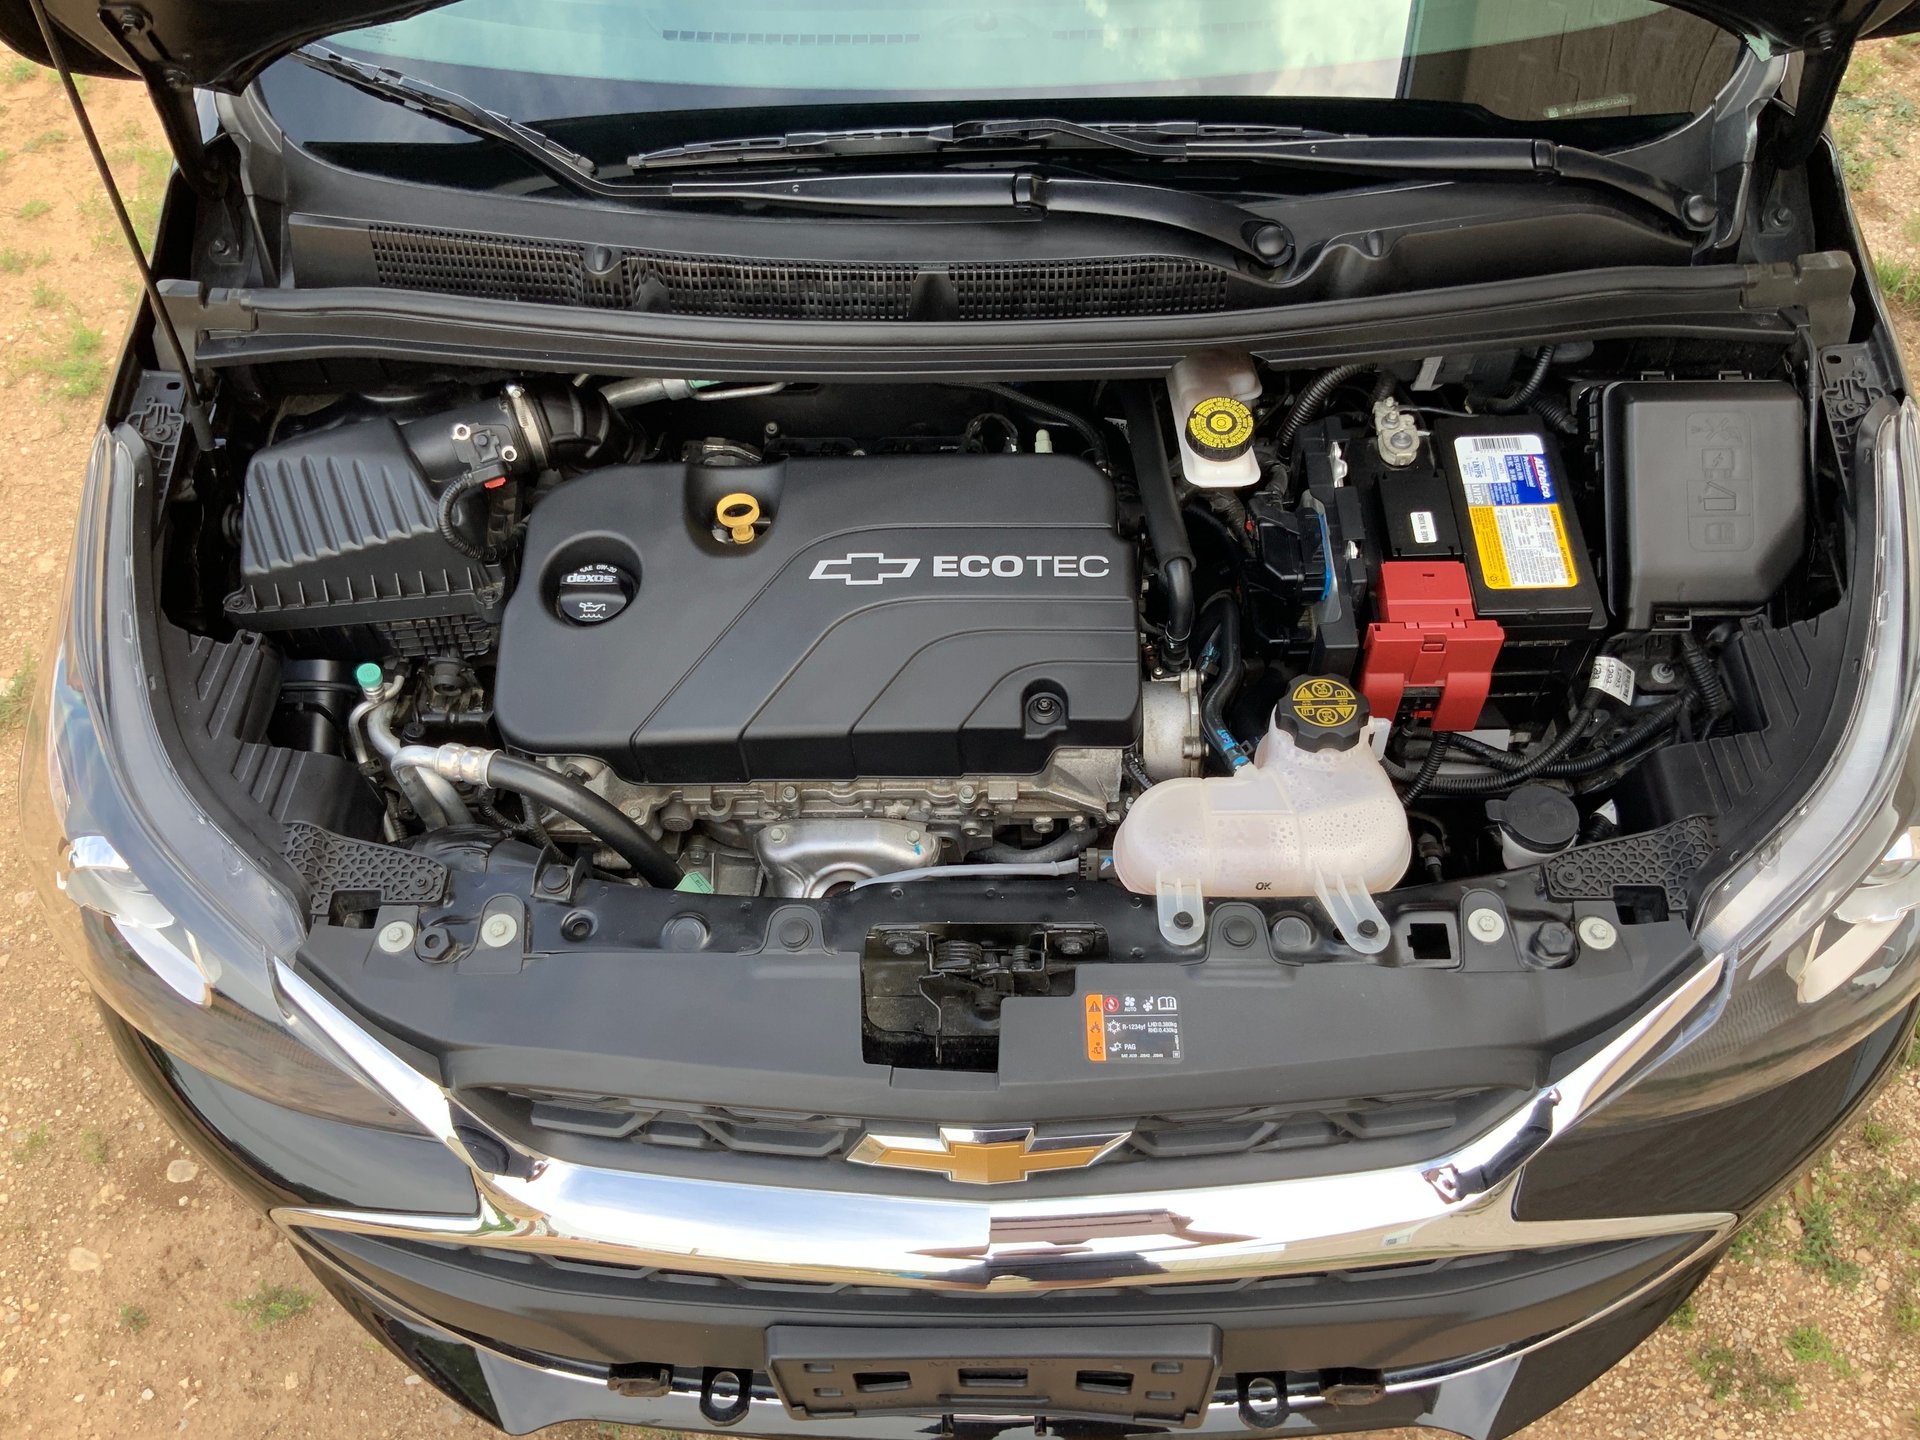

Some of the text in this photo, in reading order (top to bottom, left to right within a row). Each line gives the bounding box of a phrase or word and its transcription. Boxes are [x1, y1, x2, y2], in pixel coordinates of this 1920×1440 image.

[1533, 456, 1550, 498] ACDelco
[579, 565, 594, 573] SAE
[932, 555, 1110, 578] ECOTEC
[566, 572, 616, 583] dexos
[1255, 881, 1272, 891] OK
[1122, 1023, 1146, 1031] R-1234yf
